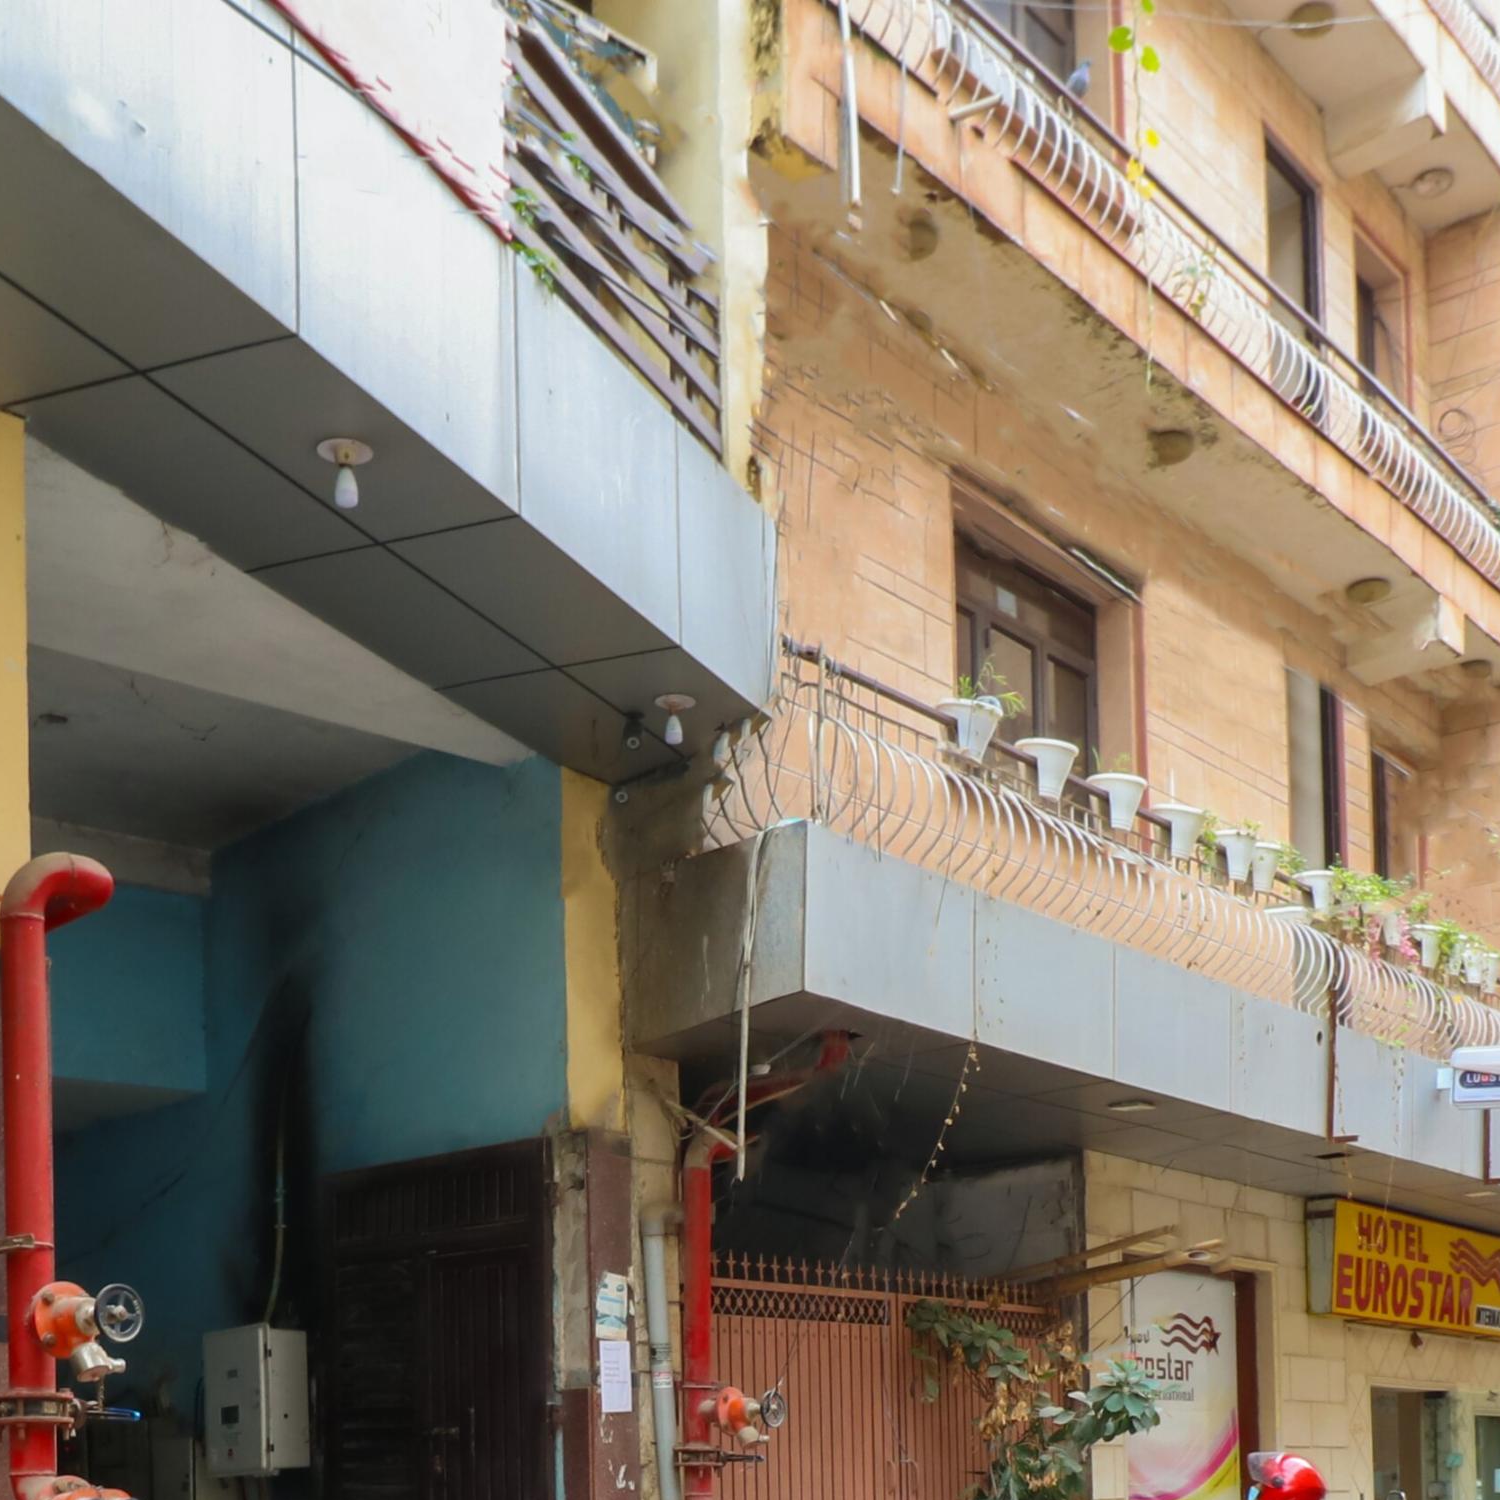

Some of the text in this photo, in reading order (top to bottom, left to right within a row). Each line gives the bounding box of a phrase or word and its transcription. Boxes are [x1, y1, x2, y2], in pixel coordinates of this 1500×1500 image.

[1358, 1212, 1428, 1263] HOTEL
[1336, 1253, 1473, 1327] EUROSTAR
[1136, 1352, 1193, 1380] rostar
